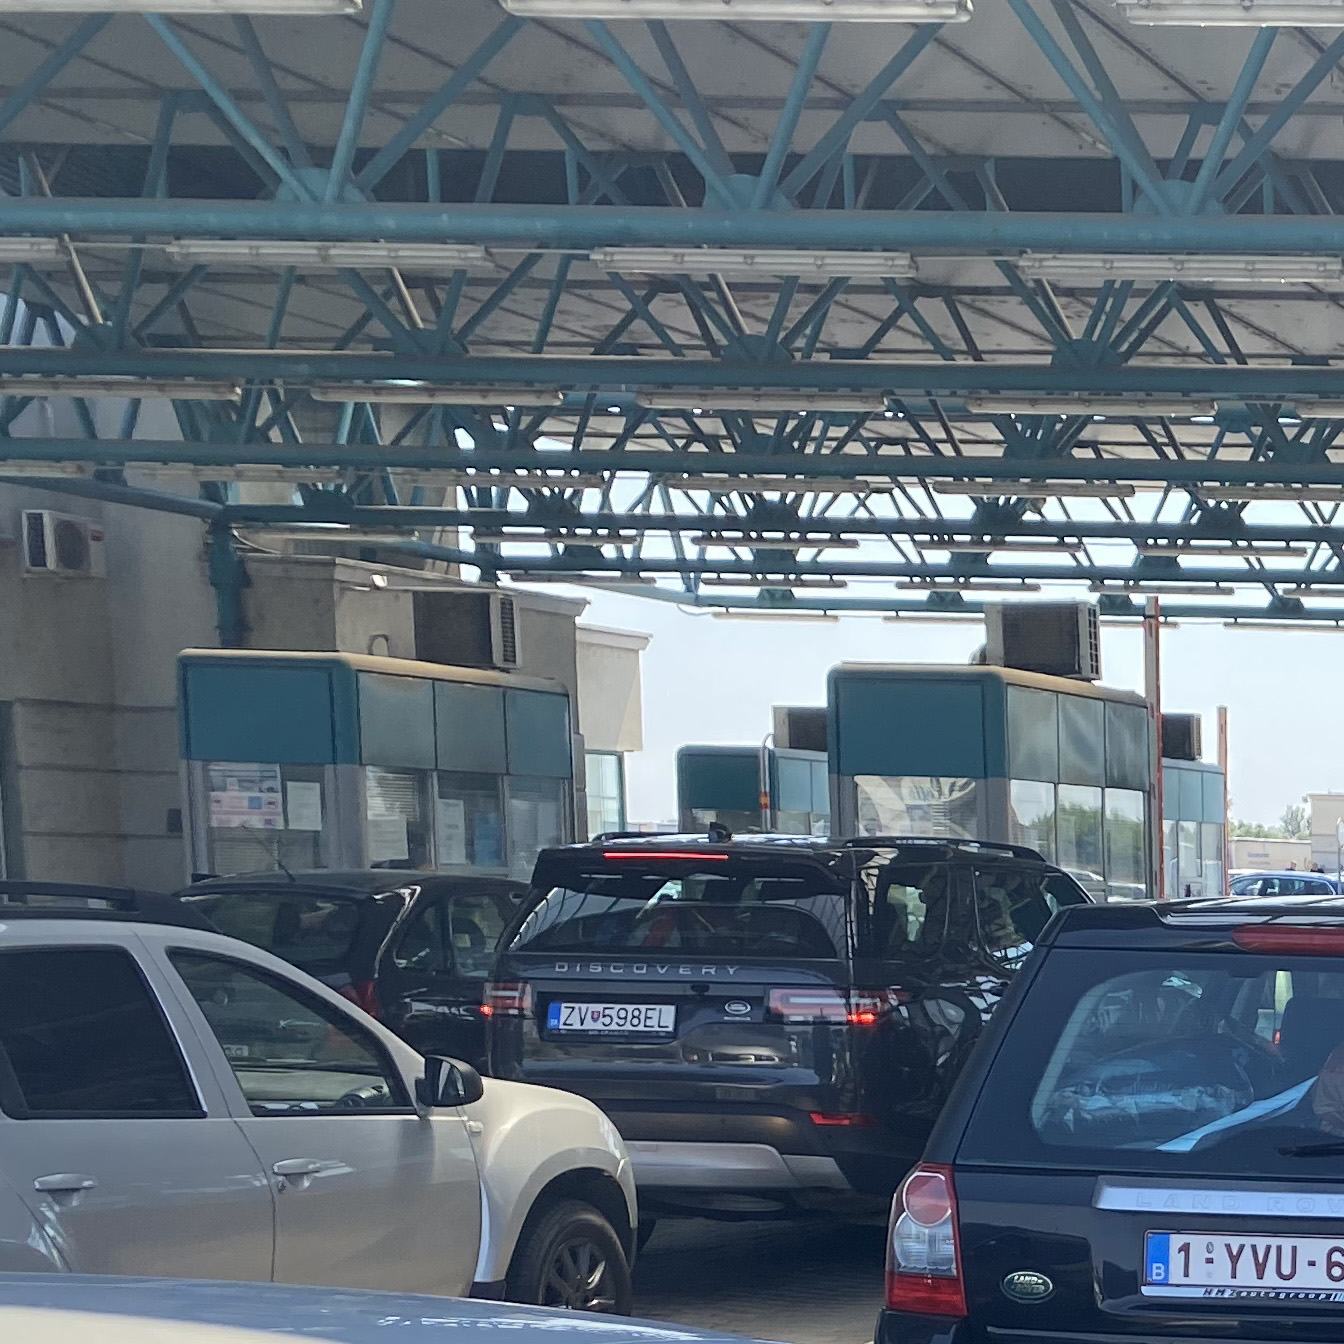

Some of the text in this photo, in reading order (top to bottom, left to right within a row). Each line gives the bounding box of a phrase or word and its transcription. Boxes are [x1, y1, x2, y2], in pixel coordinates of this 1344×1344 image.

[554, 962, 741, 975] DISCOVERY
[1135, 1191, 1240, 1211] LAND
[1151, 1262, 1165, 1280] B
